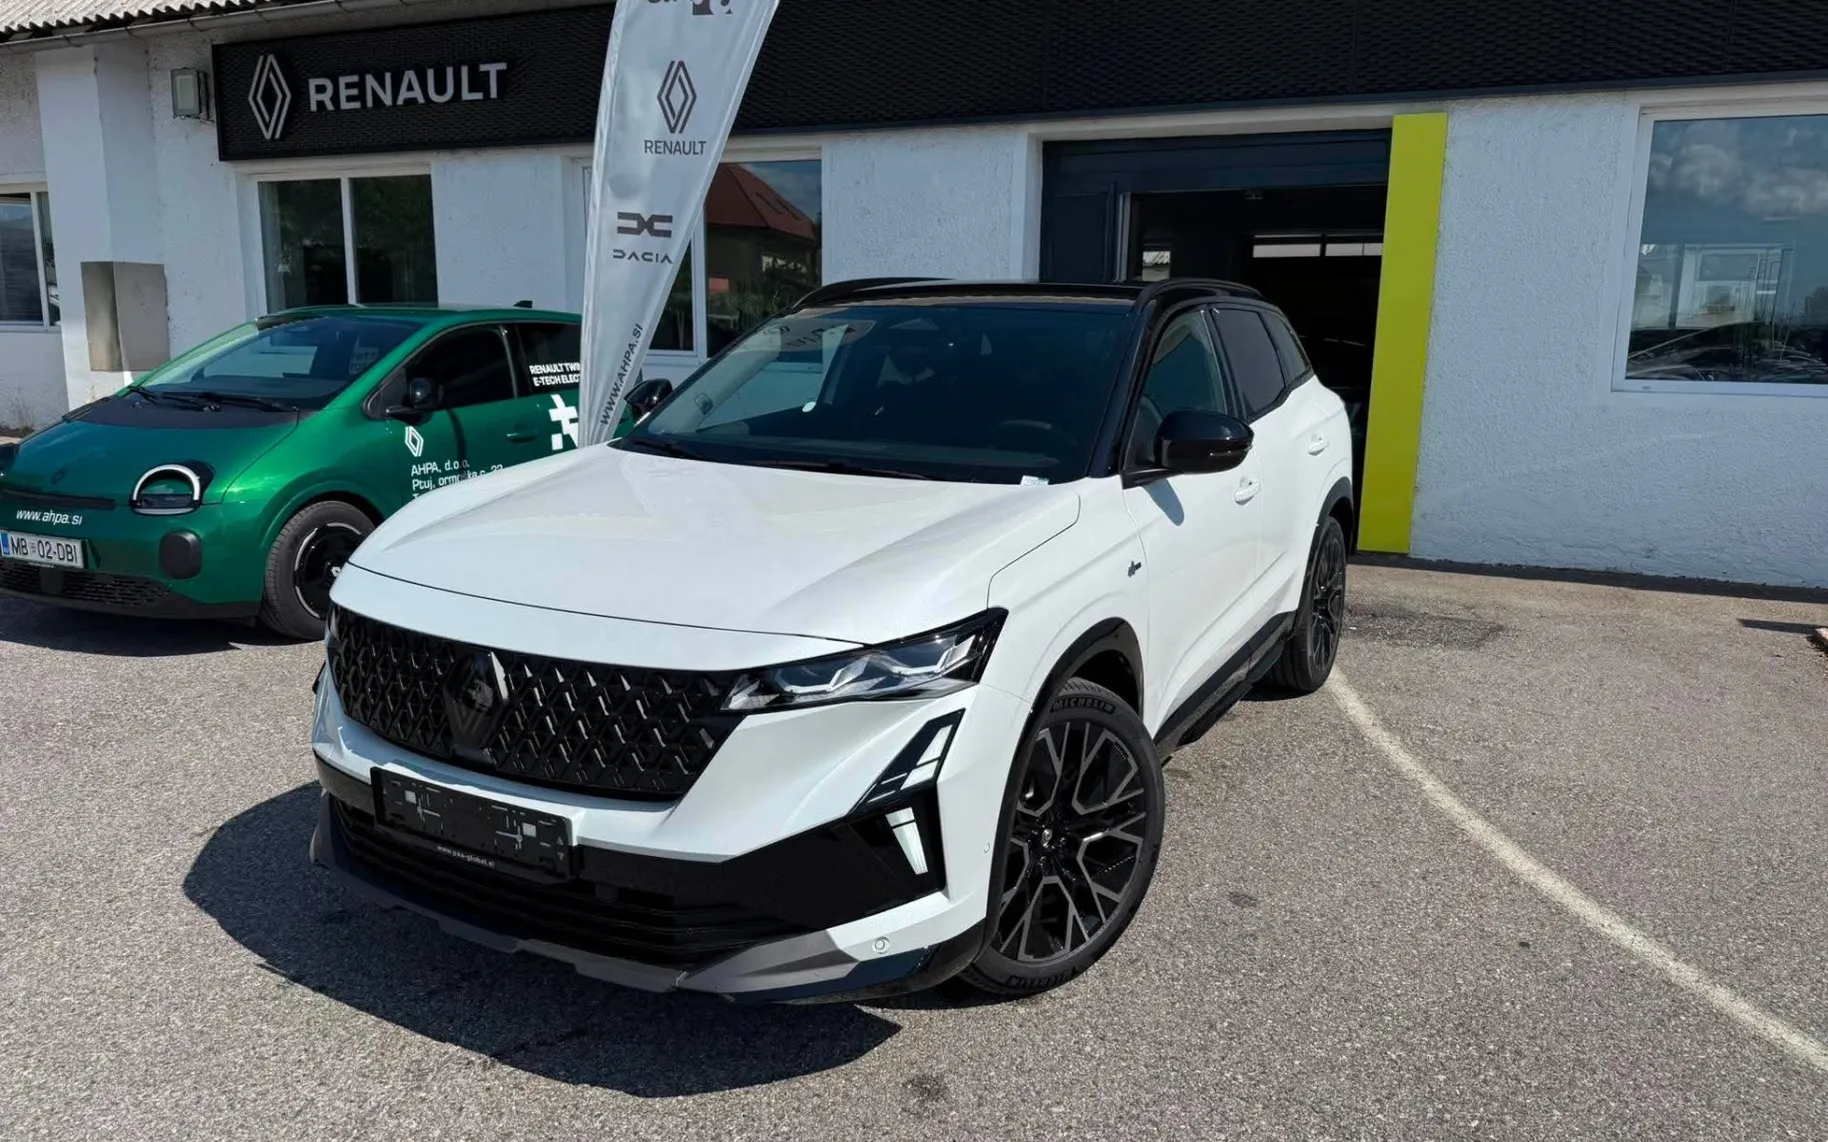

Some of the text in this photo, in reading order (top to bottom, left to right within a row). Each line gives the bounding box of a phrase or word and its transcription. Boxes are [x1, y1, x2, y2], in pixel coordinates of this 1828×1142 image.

[308, 62, 507, 112] RENAULT
[643, 139, 707, 156] RENAULT
[612, 248, 673, 264] DACIA
[529, 363, 564, 374] RENAULT
[600, 323, 643, 425] WWW.AHPA.SI
[533, 376, 561, 387] E-TECH
[16, 509, 83, 526] www.ahpa.si
[11, 536, 28, 556] MB
